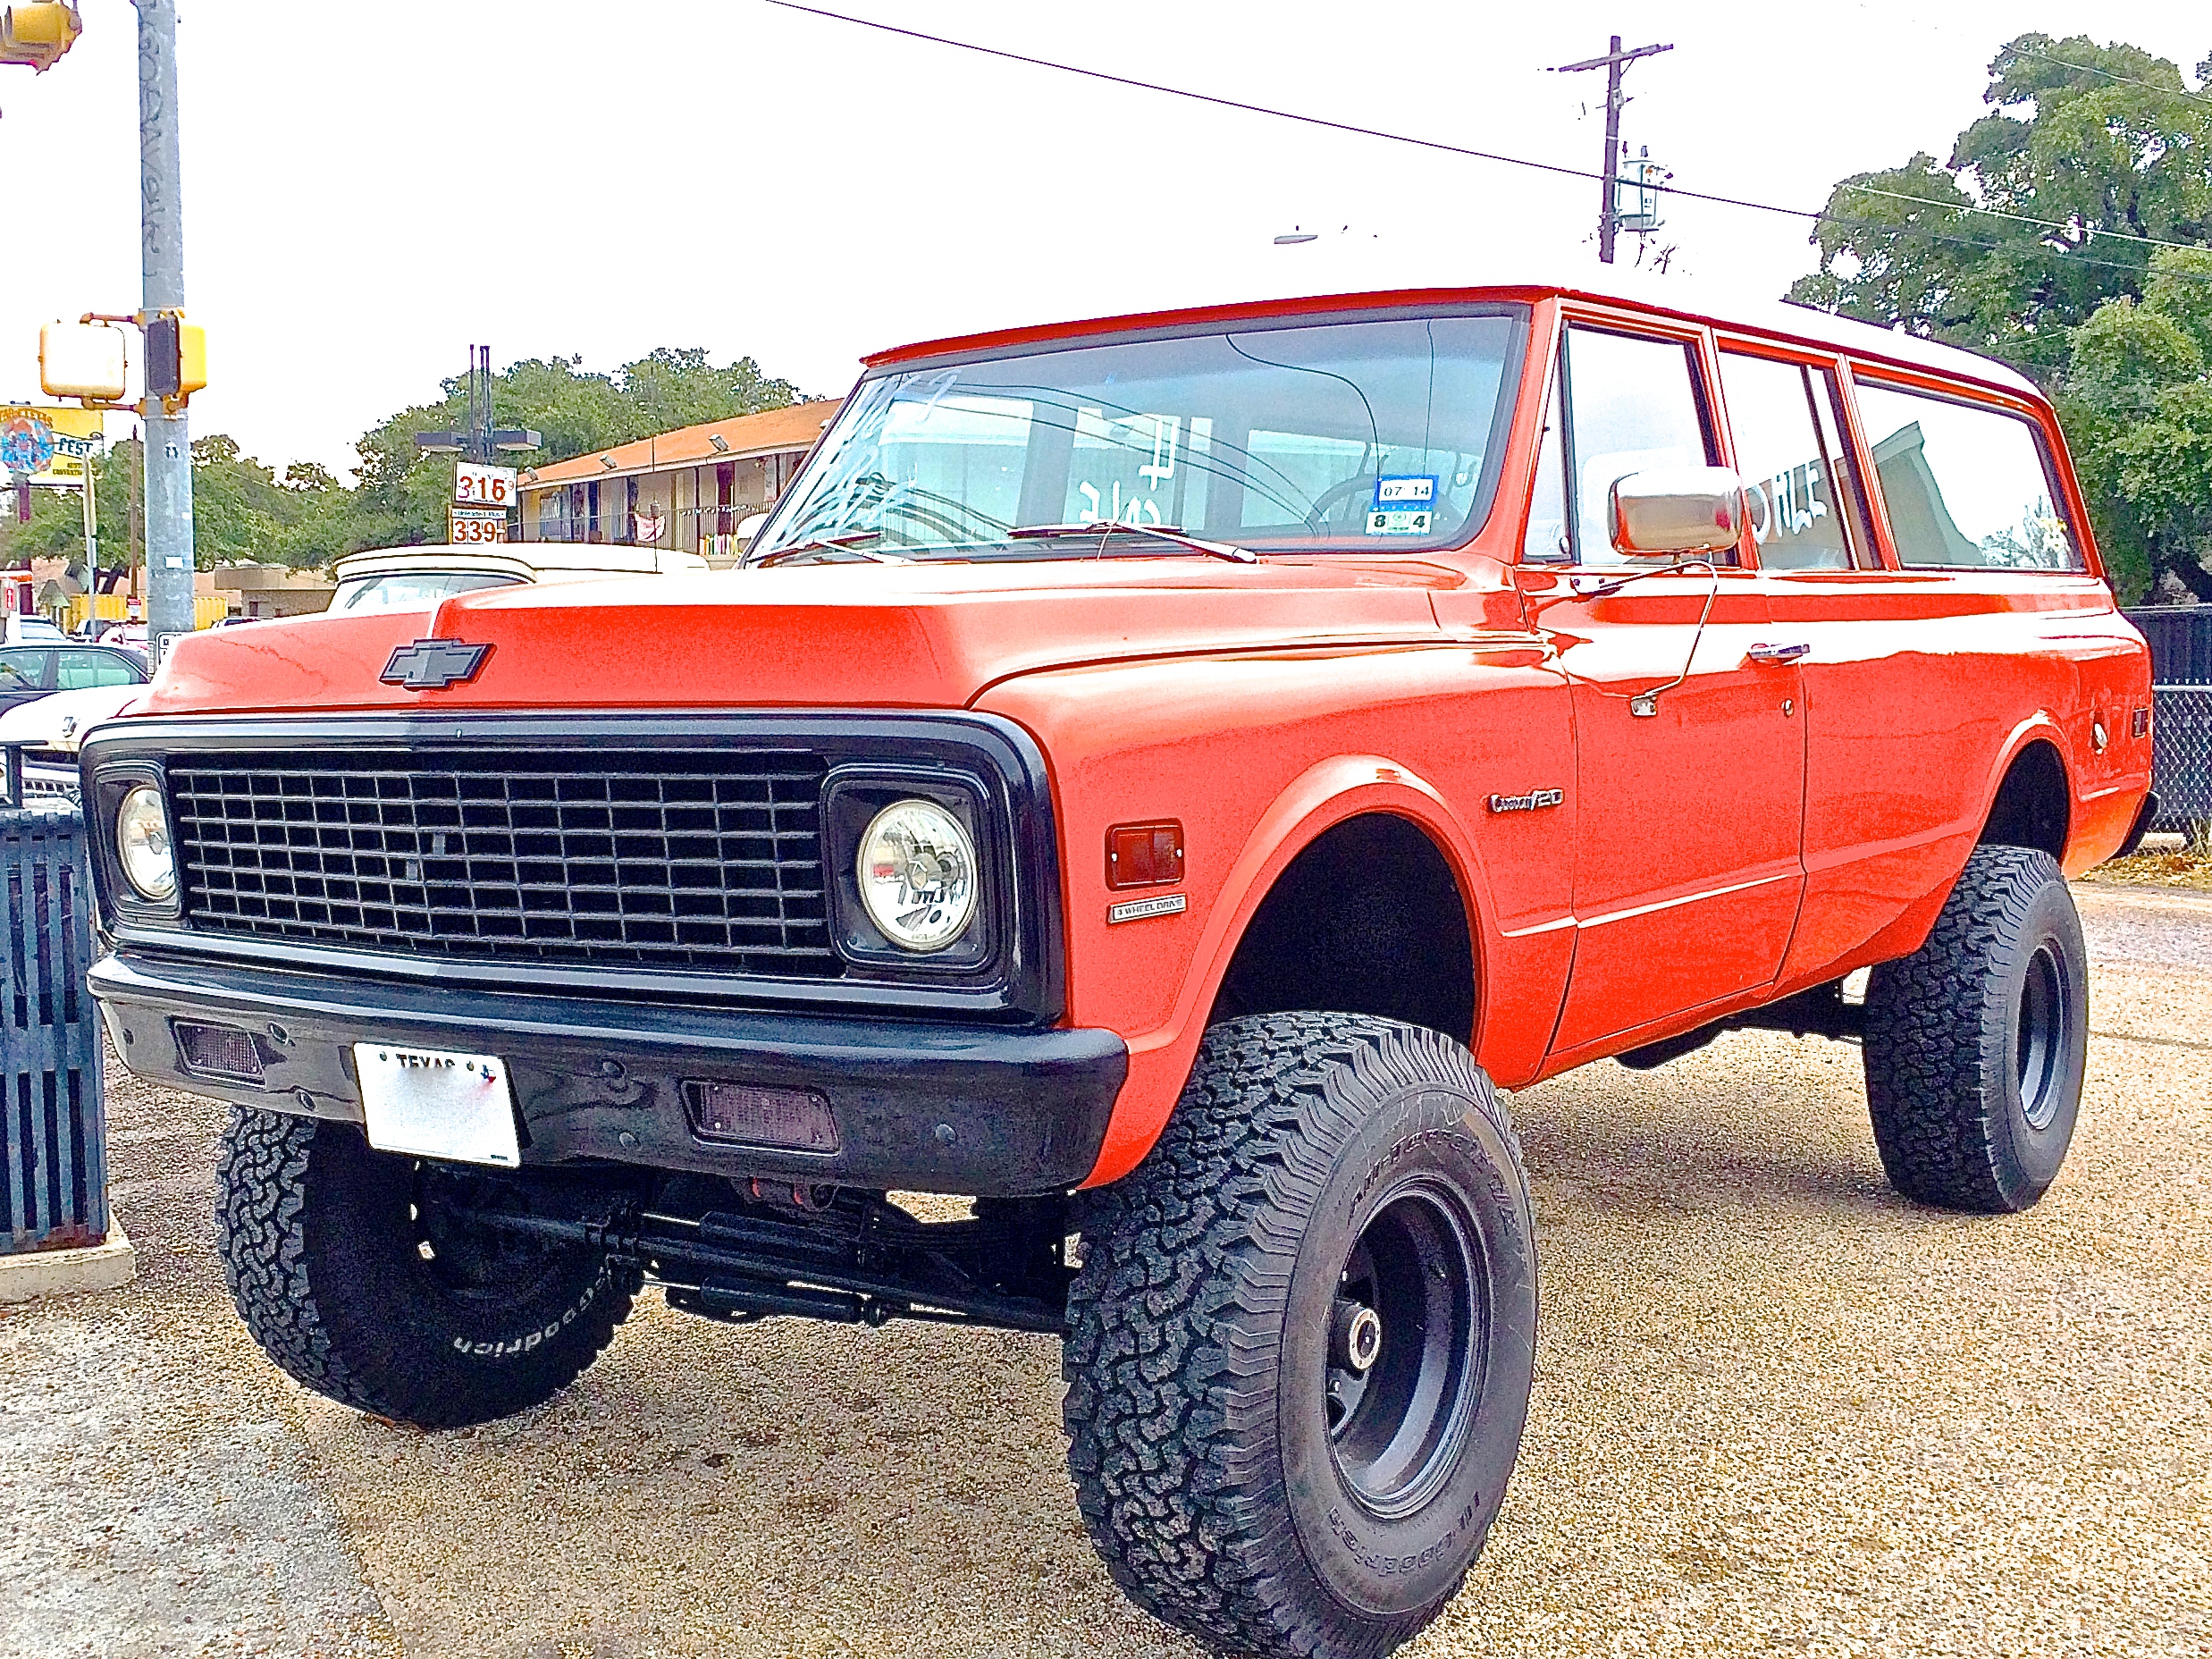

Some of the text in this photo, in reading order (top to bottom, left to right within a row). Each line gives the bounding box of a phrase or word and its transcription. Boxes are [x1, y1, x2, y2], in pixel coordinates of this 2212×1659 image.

[58, 437, 94, 456] FEST
[1413, 485, 1430, 496] 14
[1374, 514, 1426, 528] 8 4
[454, 520, 496, 543] 339
